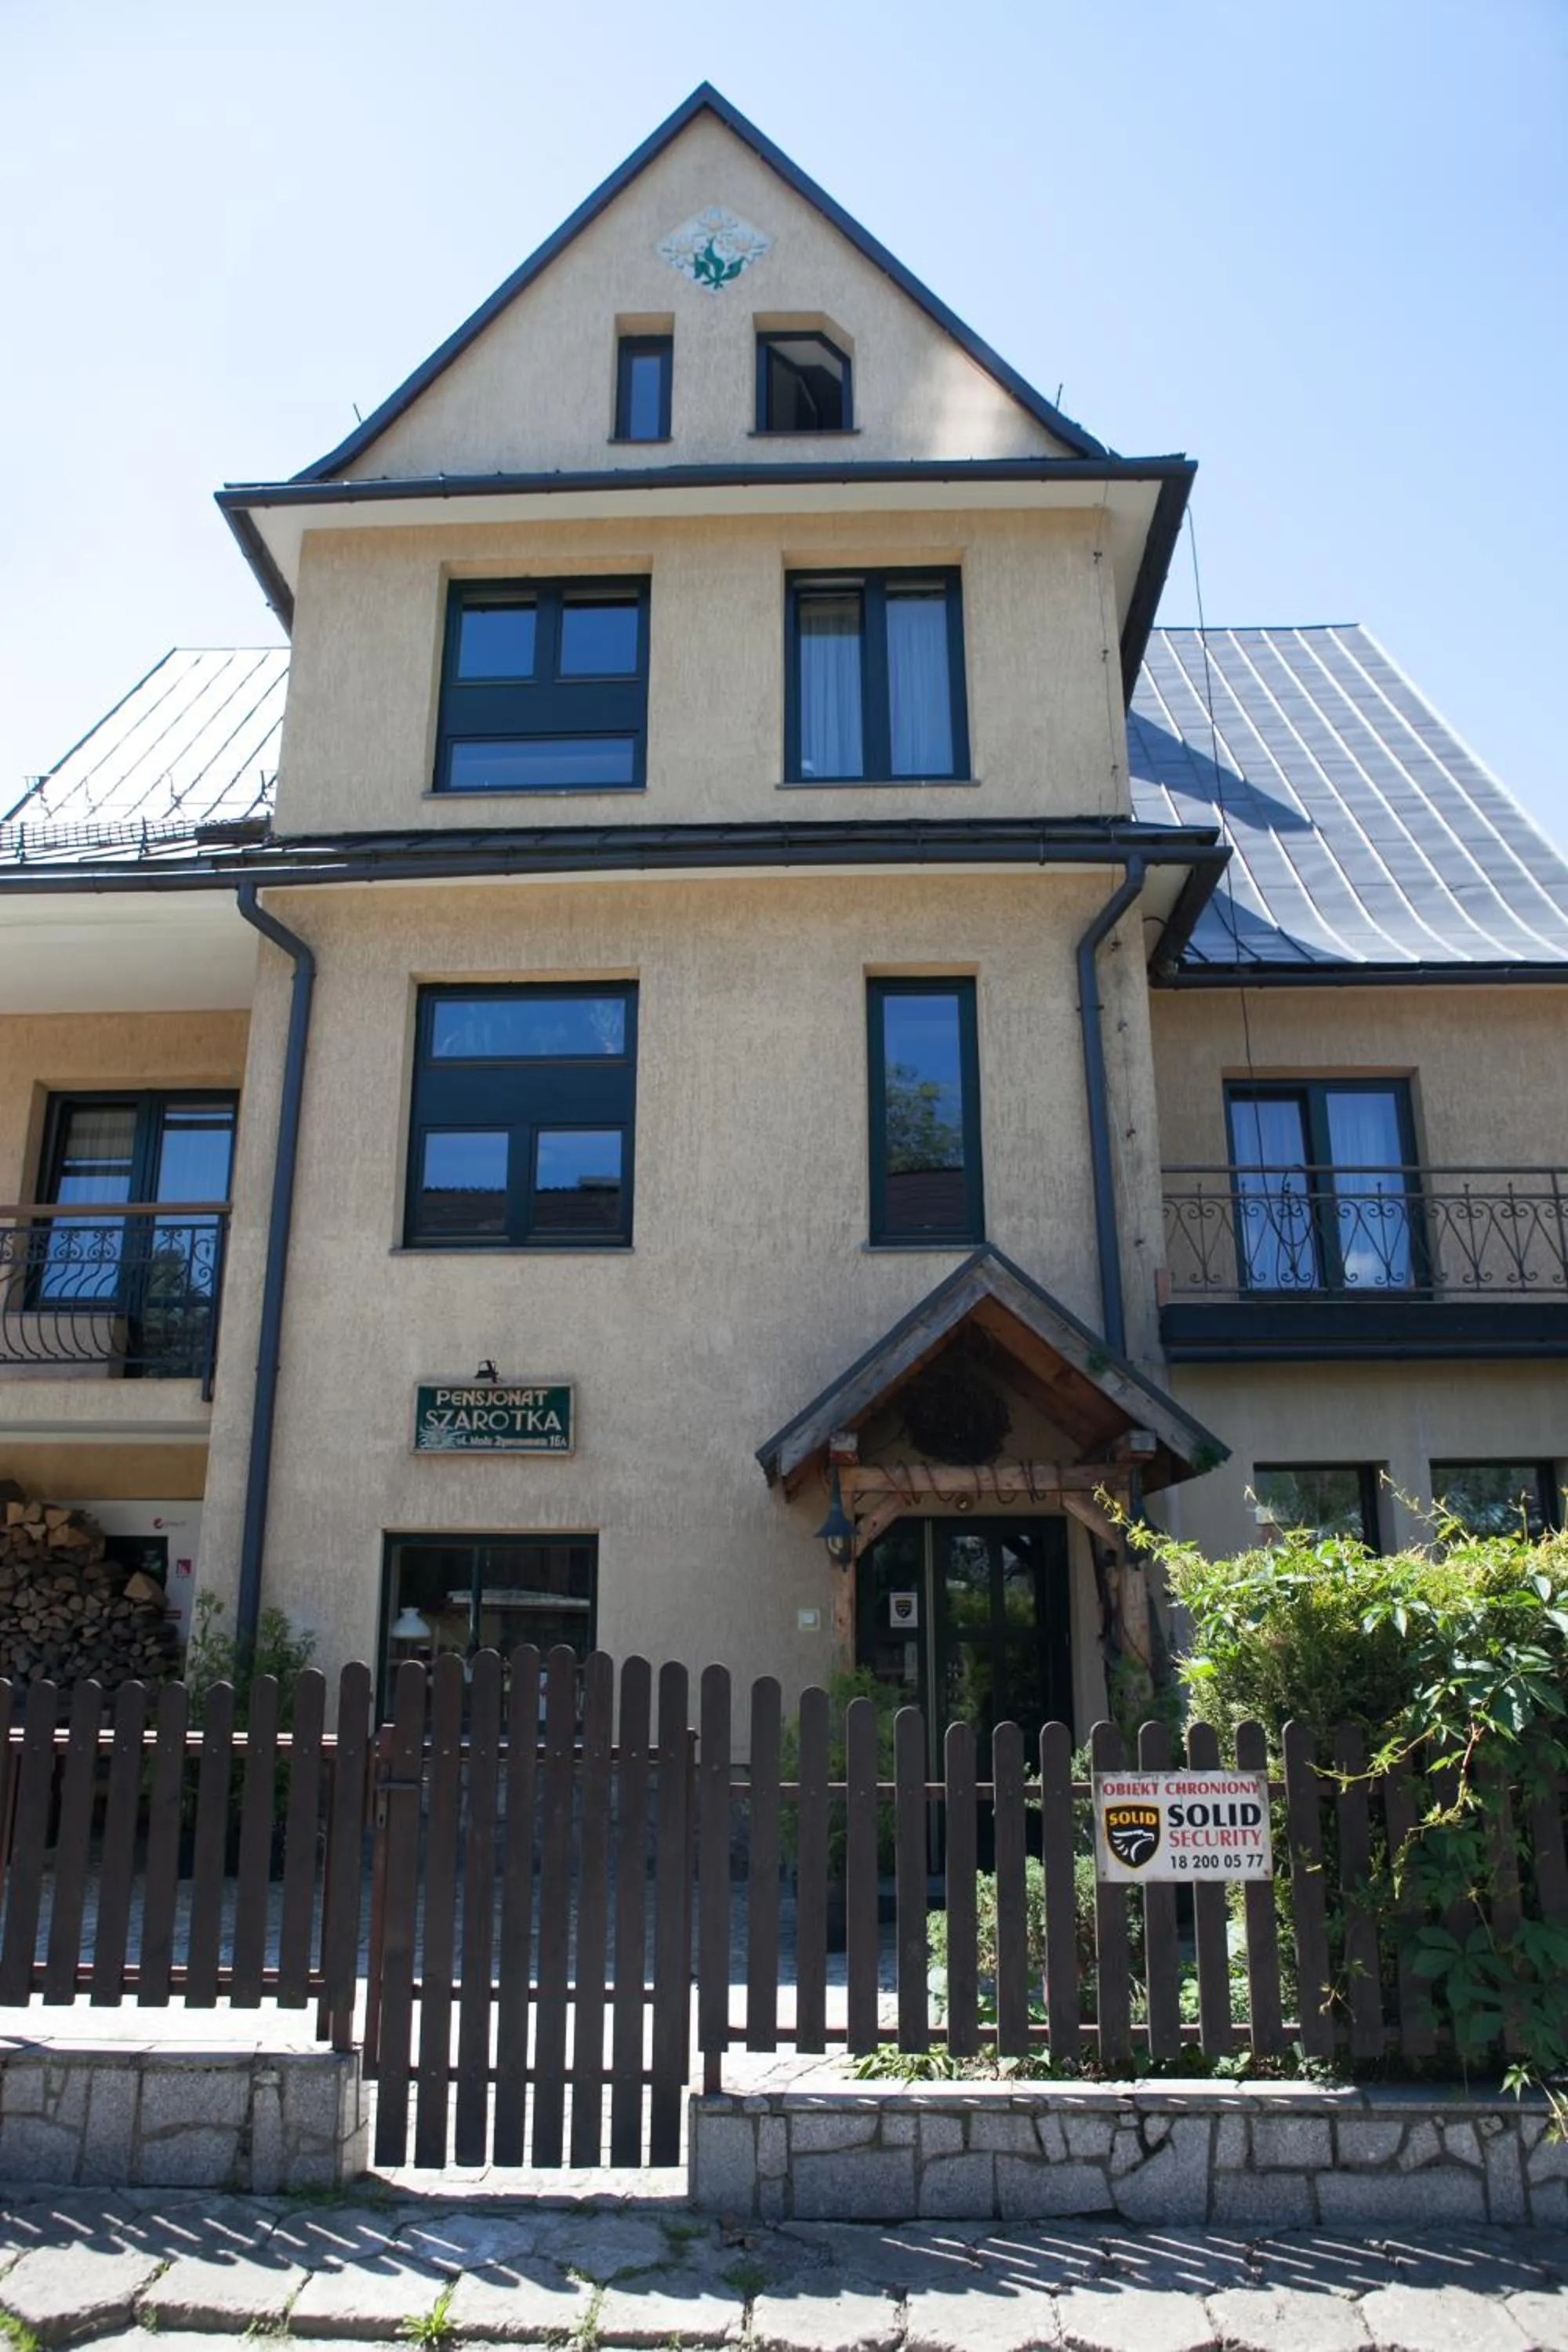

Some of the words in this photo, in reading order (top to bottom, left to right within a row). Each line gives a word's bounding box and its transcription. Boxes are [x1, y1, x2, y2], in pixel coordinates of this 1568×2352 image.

[437, 1390, 548, 1406] PENSJONAT
[426, 1410, 562, 1432] SZAROTKA
[1103, 1782, 1159, 1796] OBIEKT
[1165, 1780, 1260, 1795] CHRONIONY
[1109, 1811, 1157, 1826] SOLID
[1167, 1803, 1261, 1828] SOLID
[1169, 1829, 1262, 1848] SECURITY
[1171, 1855, 1188, 1869] 18
[1192, 1855, 1219, 1869] 200
[1224, 1854, 1242, 1868] 05
[1247, 1854, 1264, 1867] 77
